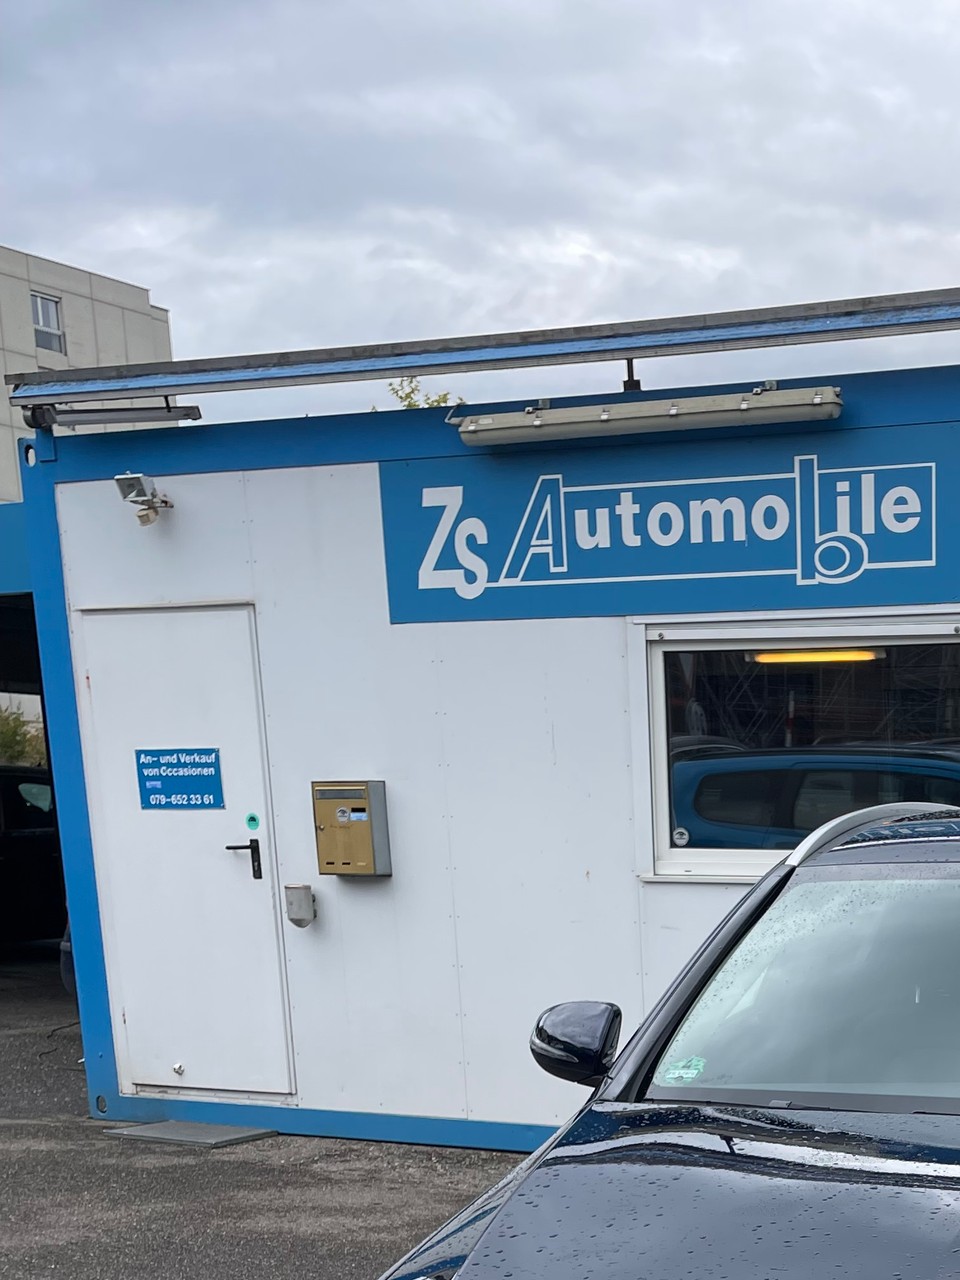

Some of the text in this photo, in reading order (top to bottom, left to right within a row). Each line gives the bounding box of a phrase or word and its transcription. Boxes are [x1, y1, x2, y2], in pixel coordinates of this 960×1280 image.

[418, 455, 922, 599] Zs Automobile
[160, 753, 177, 764] und
[179, 752, 216, 764] Verkauf
[142, 766, 215, 776] von Occasionen
[189, 794, 202, 805] 33
[203, 794, 214, 805] 61
